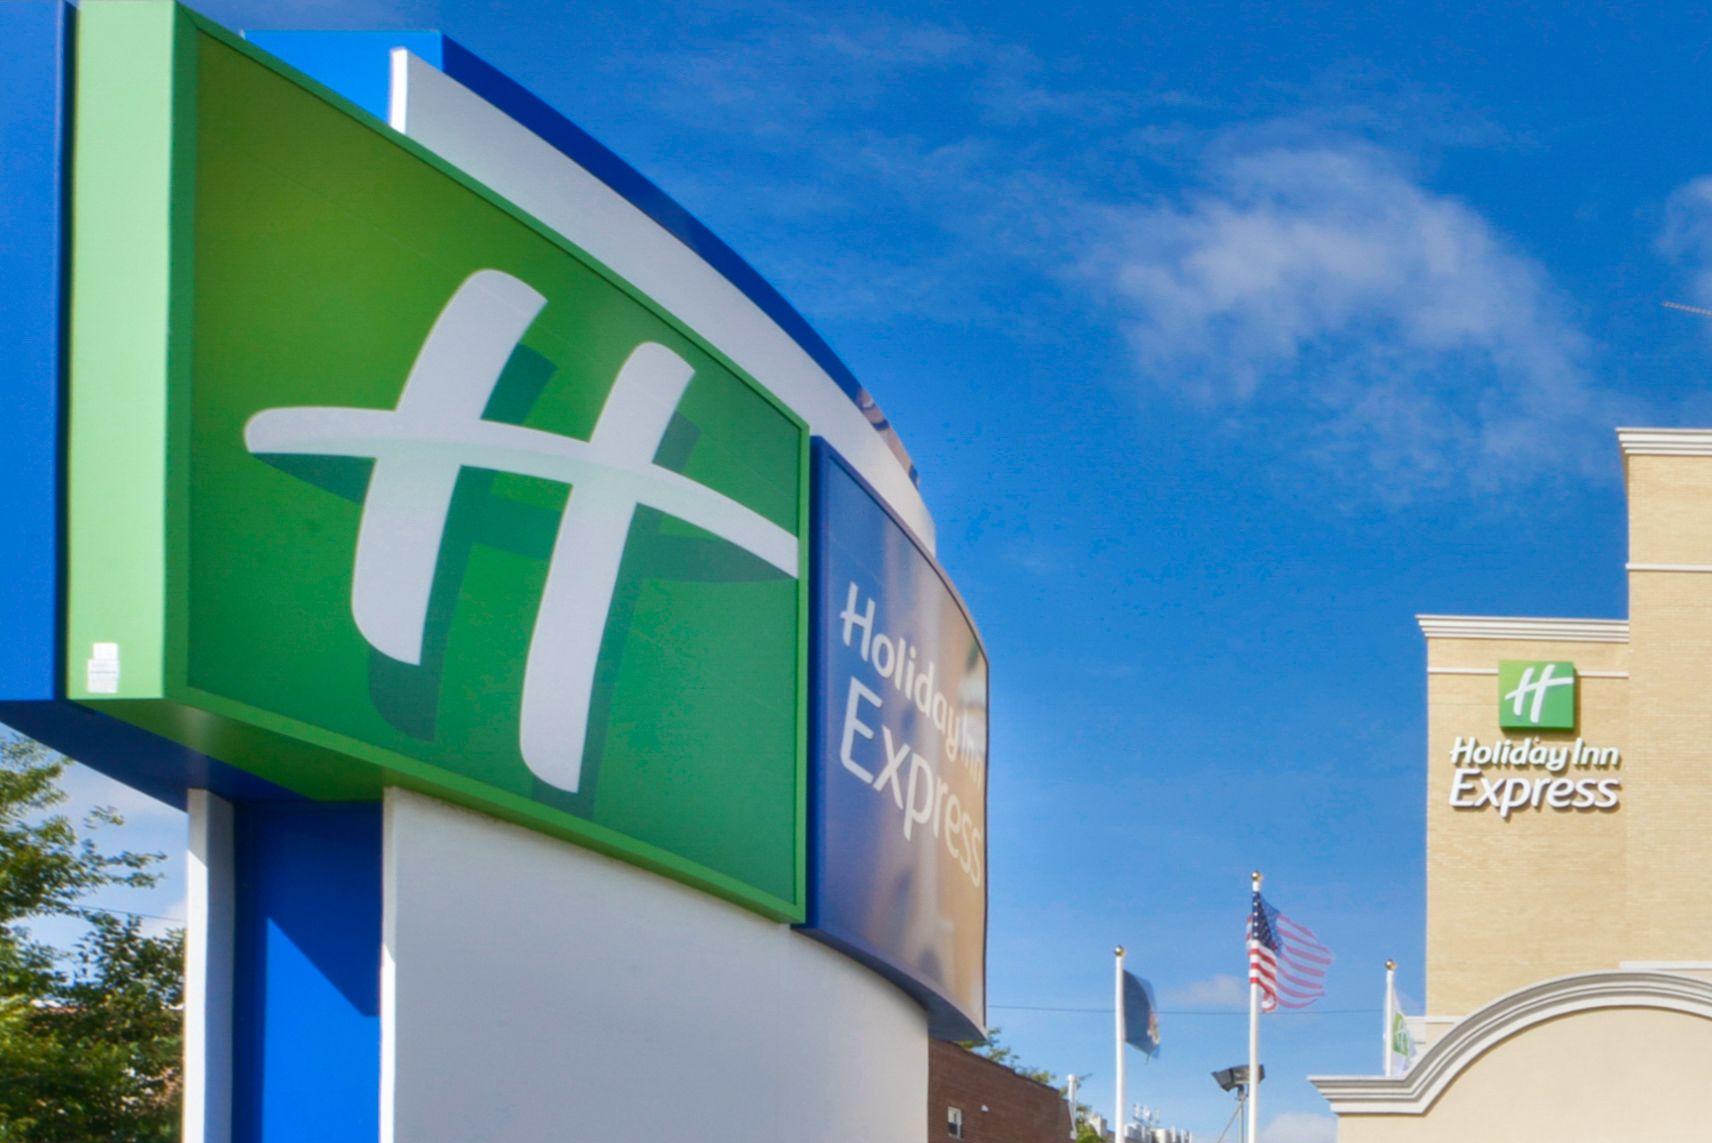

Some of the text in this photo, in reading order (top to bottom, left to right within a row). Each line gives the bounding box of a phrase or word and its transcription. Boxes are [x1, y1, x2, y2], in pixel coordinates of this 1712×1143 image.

[840, 581, 983, 792] Holiday Inn
[840, 676, 982, 888] Express
[1449, 768, 1620, 818] Express
[1450, 736, 1620, 770] Holiday Inn
